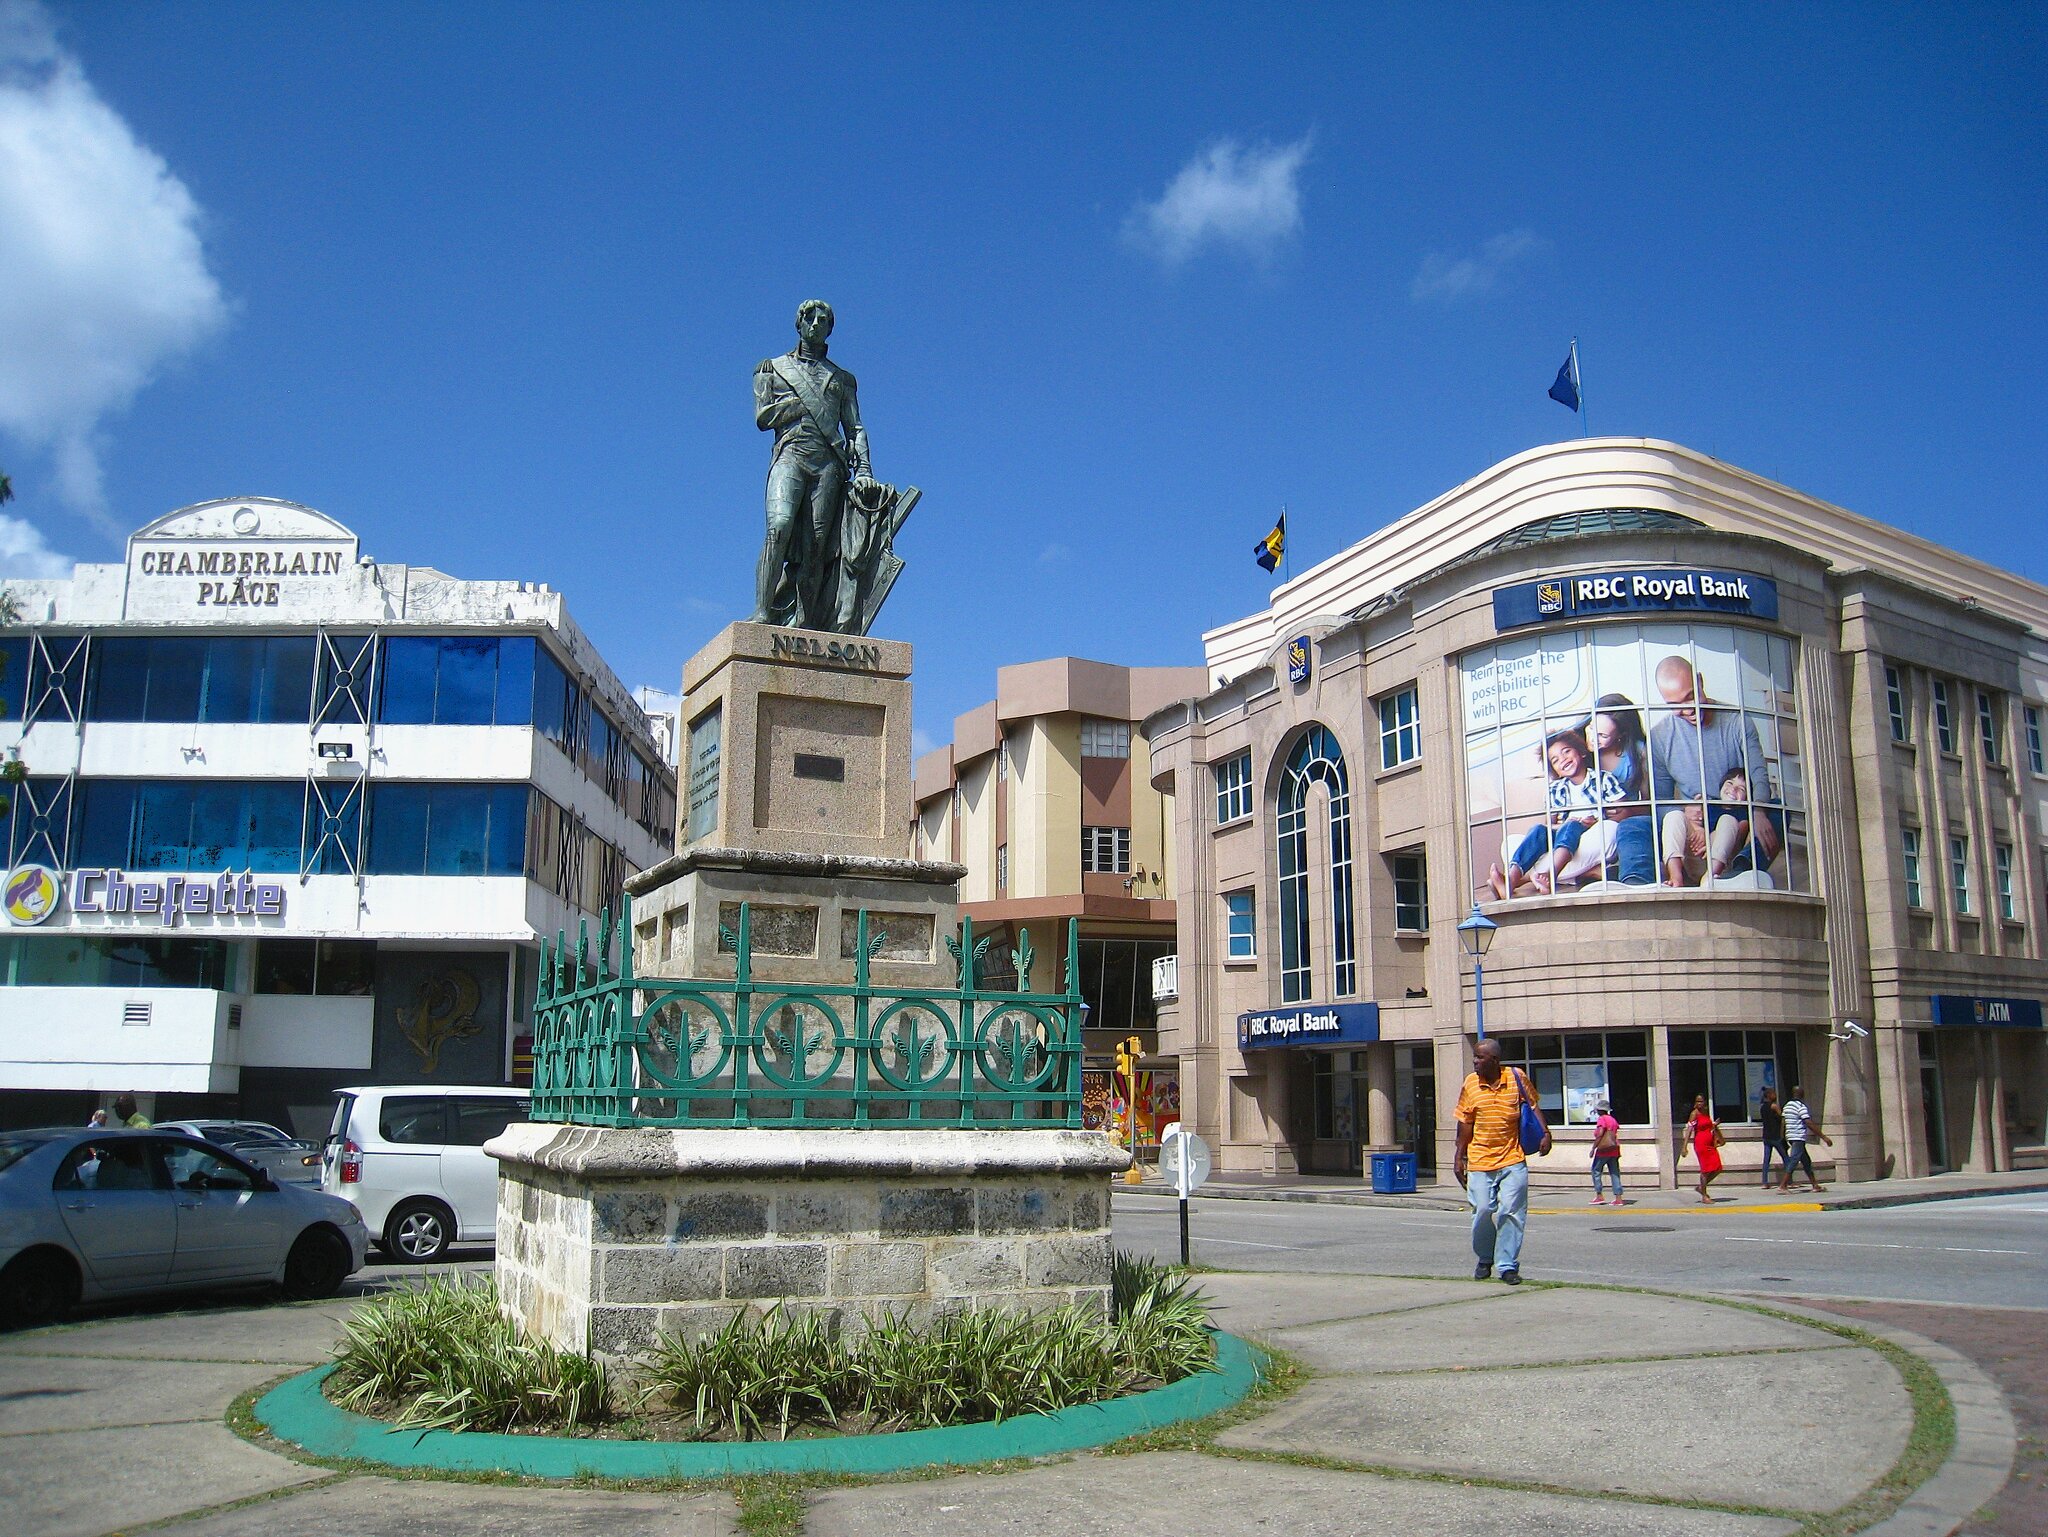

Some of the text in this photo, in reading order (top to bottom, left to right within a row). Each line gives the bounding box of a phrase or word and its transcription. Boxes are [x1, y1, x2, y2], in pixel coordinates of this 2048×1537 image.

[141, 551, 342, 575] CHAMBERLAIN
[197, 581, 281, 605] PLACE
[1578, 574, 1750, 600] RBC Royal Bank
[1541, 602, 1560, 612] RBC
[771, 633, 881, 663] NELSON
[1290, 666, 1306, 681] RBC
[1470, 651, 1565, 682] Reimagine the
[1472, 674, 1551, 705] possibilities
[1472, 695, 1527, 719] with RBC
[73, 866, 281, 927] Chefette
[1251, 1010, 1340, 1038] RBC Royal Bank
[1988, 1002, 2010, 1021] ATM
